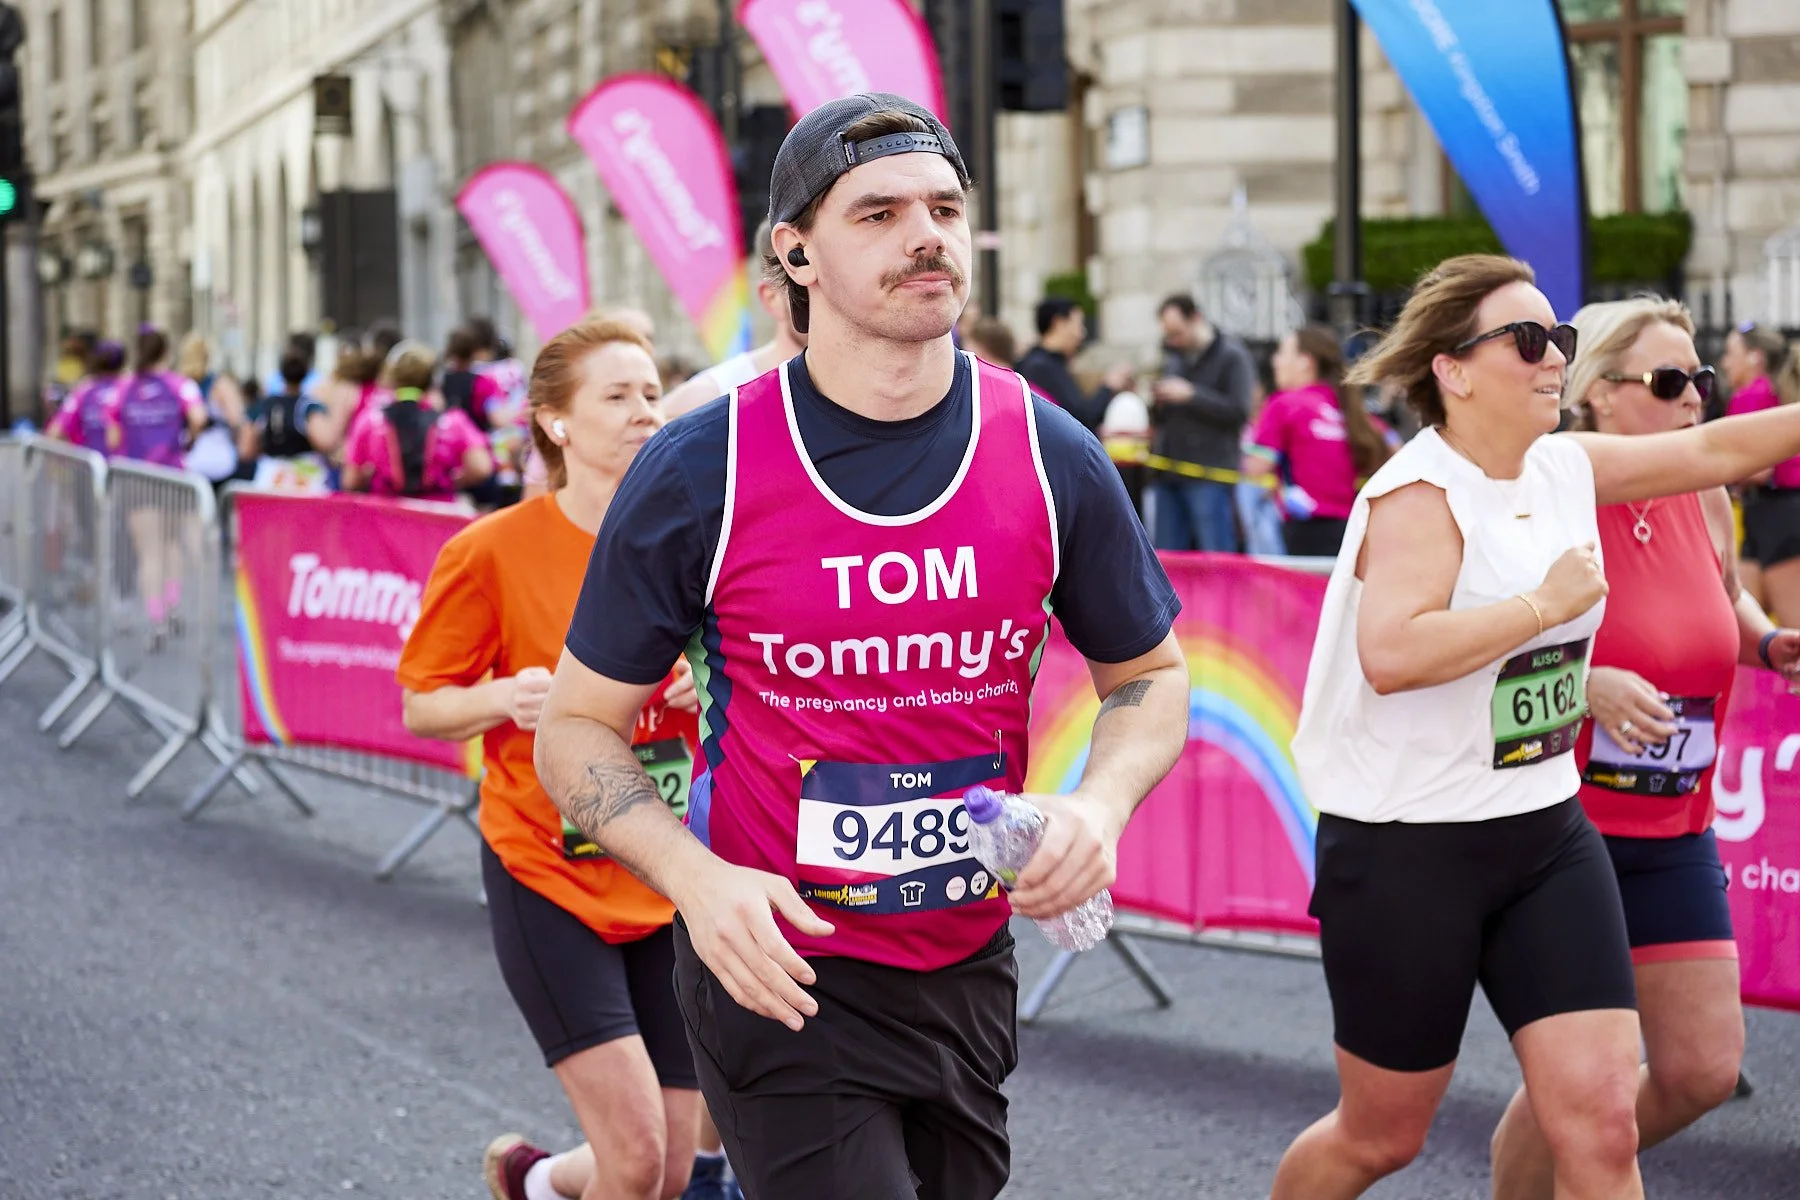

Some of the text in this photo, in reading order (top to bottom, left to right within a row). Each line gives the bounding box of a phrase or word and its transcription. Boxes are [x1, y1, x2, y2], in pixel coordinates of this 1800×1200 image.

[287, 553, 420, 641] Tommy
[821, 545, 978, 609] TOM
[748, 619, 1029, 679] Tommy's
[758, 691, 791, 711] The
[795, 693, 888, 713] pregnancy
[893, 690, 927, 708] and
[930, 688, 974, 705] baby
[1513, 673, 1576, 725] 6162
[889, 772, 933, 789] TOM
[832, 807, 971, 860] 9489
[814, 888, 840, 900] LONDON
